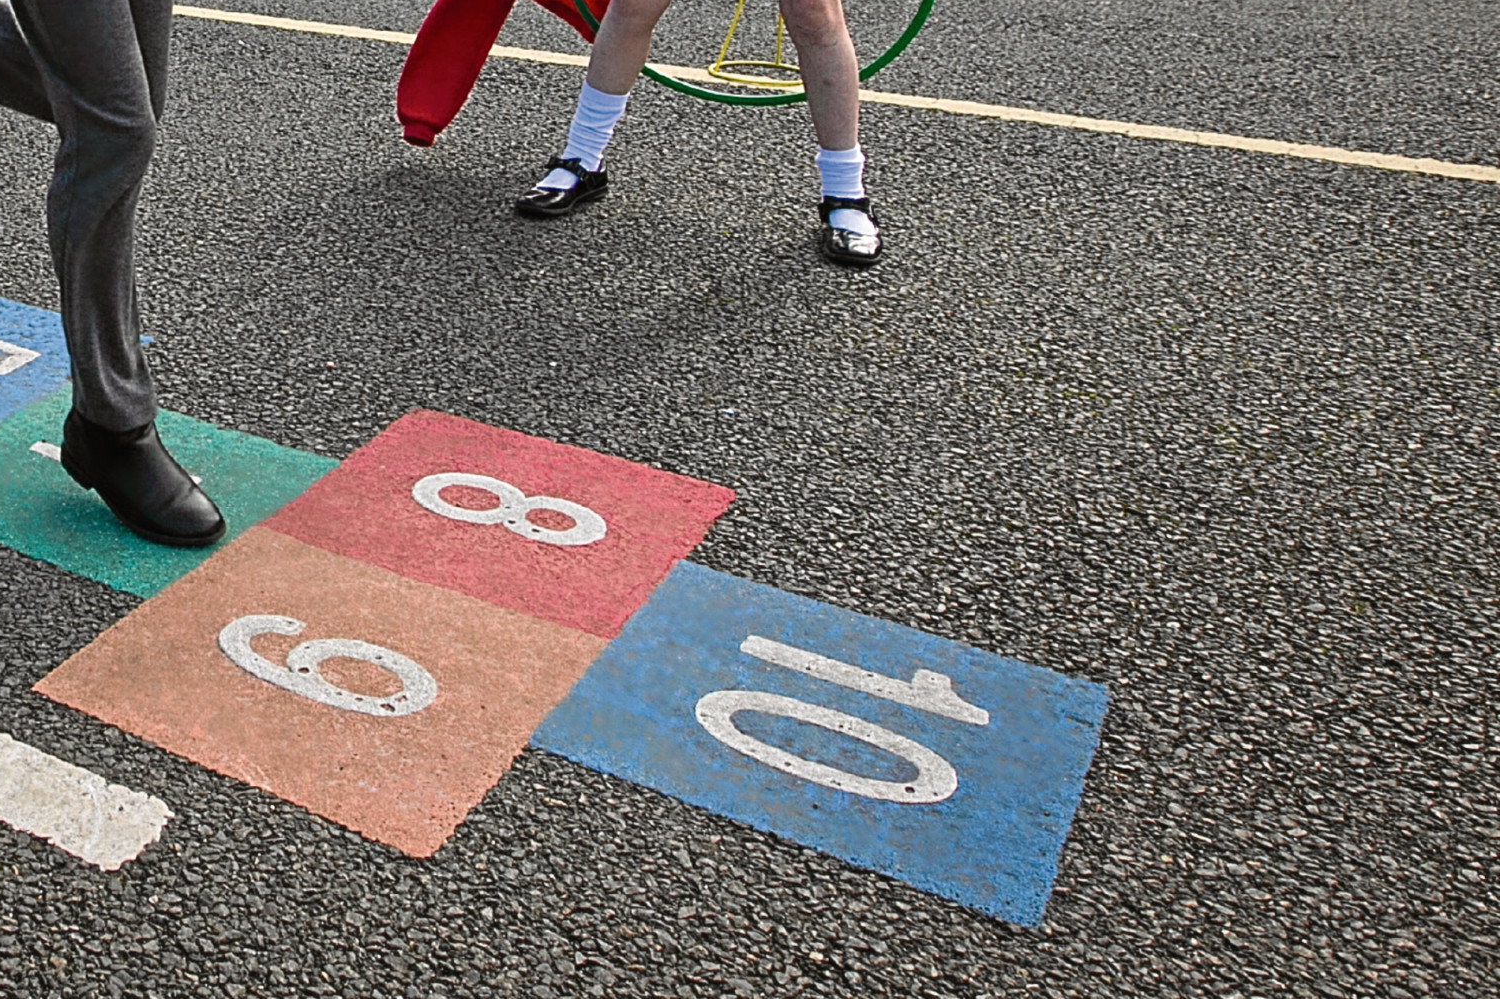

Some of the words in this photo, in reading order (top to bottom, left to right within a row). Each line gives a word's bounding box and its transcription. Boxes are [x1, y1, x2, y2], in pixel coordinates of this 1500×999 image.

[412, 473, 607, 545] 8
[218, 614, 438, 717] 9
[694, 634, 990, 805] 10
